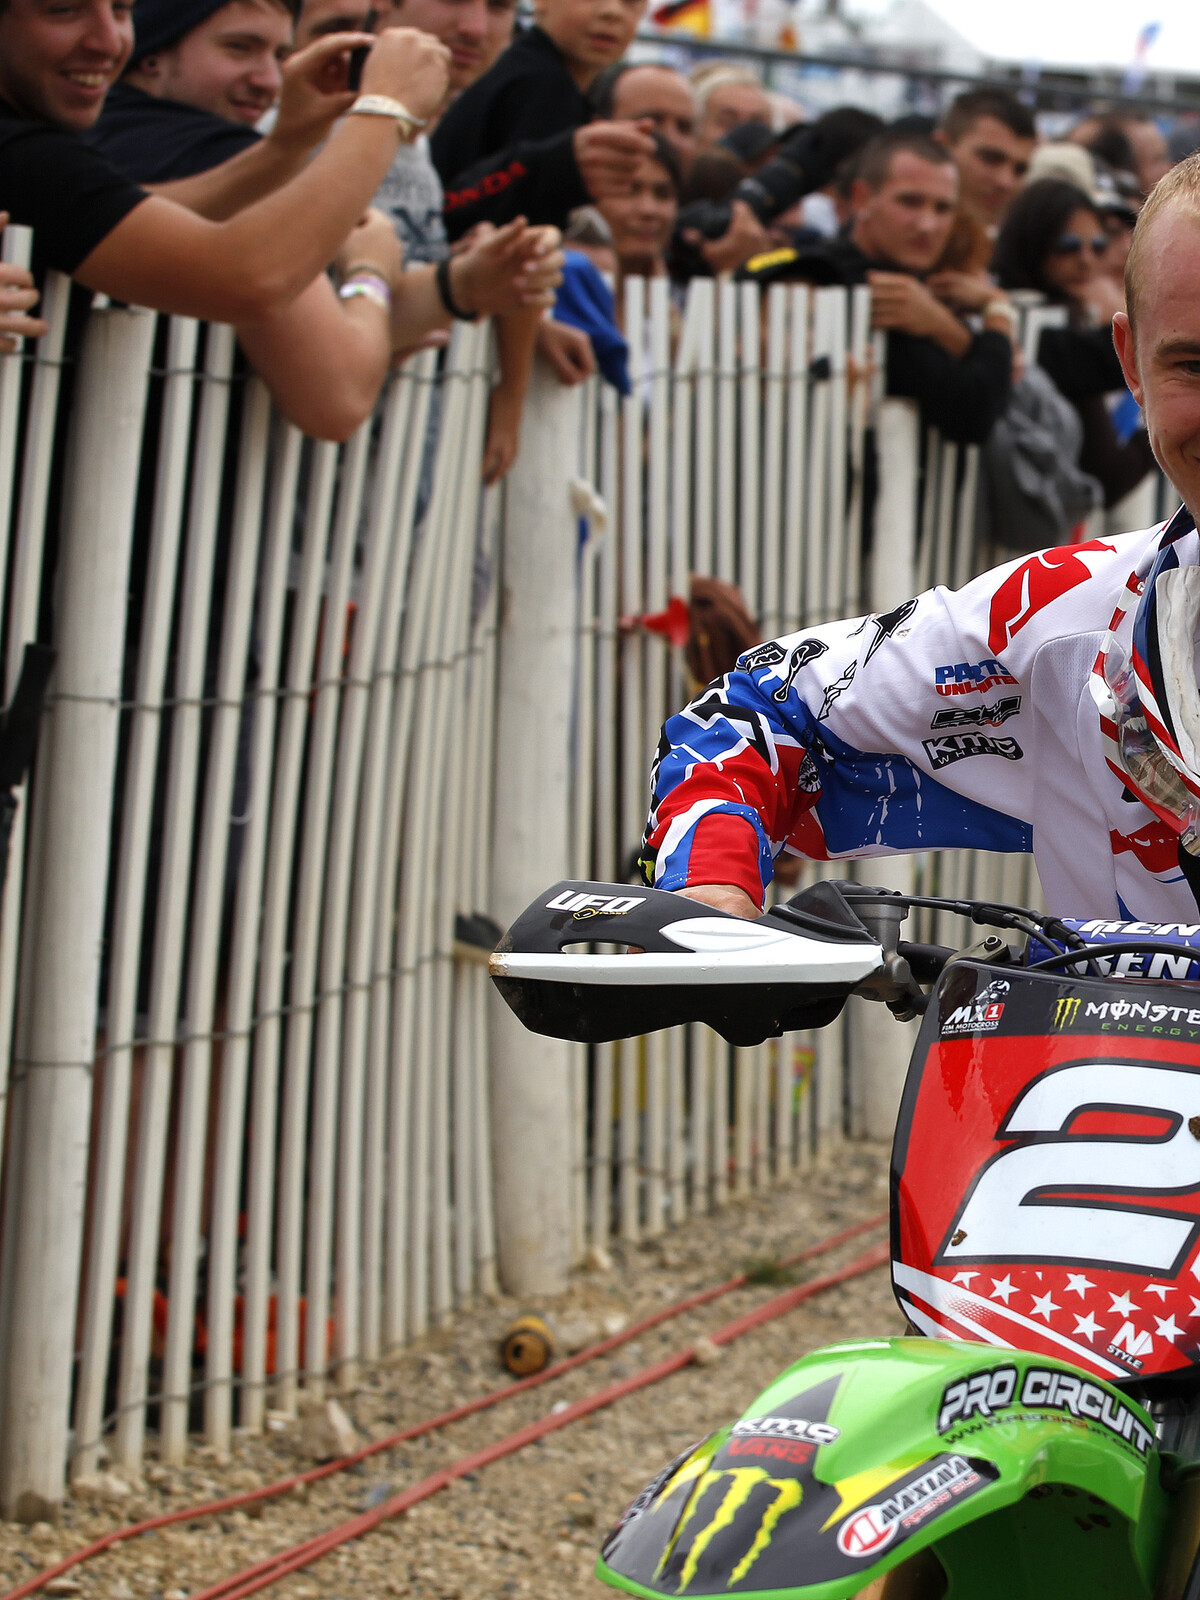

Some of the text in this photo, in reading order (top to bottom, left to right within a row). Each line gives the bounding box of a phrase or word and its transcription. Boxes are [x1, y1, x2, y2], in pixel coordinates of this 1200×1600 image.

[545, 889, 647, 913] UFO
[1101, 1022, 1199, 1038] ENERGY
[1106, 1344, 1144, 1370] STYLE
[939, 1368, 1154, 1454] PRO CIRCUIT
